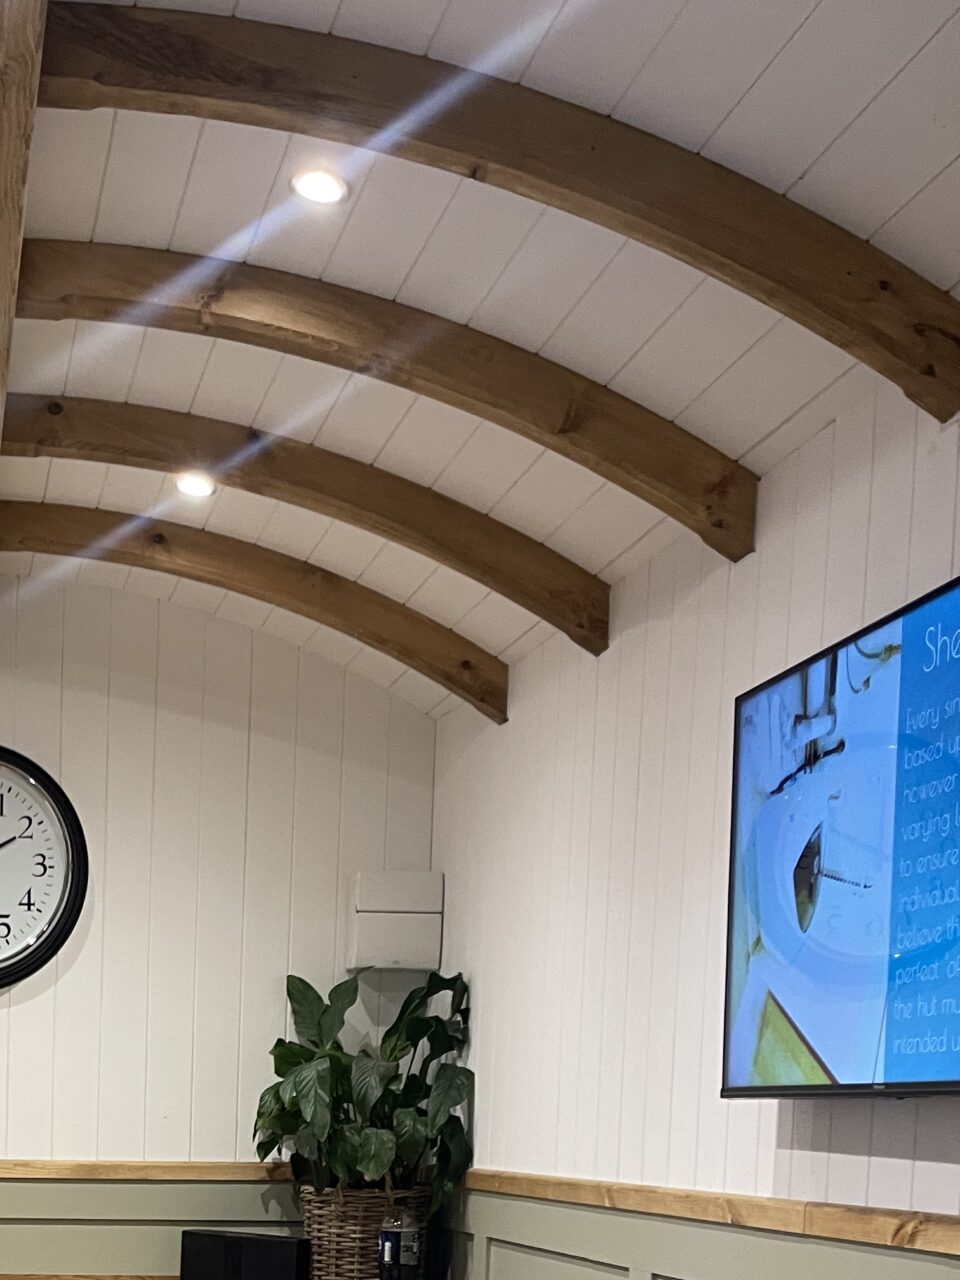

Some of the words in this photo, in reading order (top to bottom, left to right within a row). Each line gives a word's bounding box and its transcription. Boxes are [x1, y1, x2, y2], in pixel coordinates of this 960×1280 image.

[906, 705, 940, 734] Every
[904, 732, 944, 770] based
[903, 773, 959, 806] however
[17, 815, 34, 840] 2
[902, 813, 951, 842] varying
[31, 853, 47, 877] 3
[900, 857, 912, 877] to
[916, 848, 959, 874] ensure
[18, 887, 36, 912] 4
[895, 960, 939, 990] perfect
[894, 995, 912, 1019] the
[918, 993, 938, 1017] hut
[893, 1026, 947, 1055] intended
